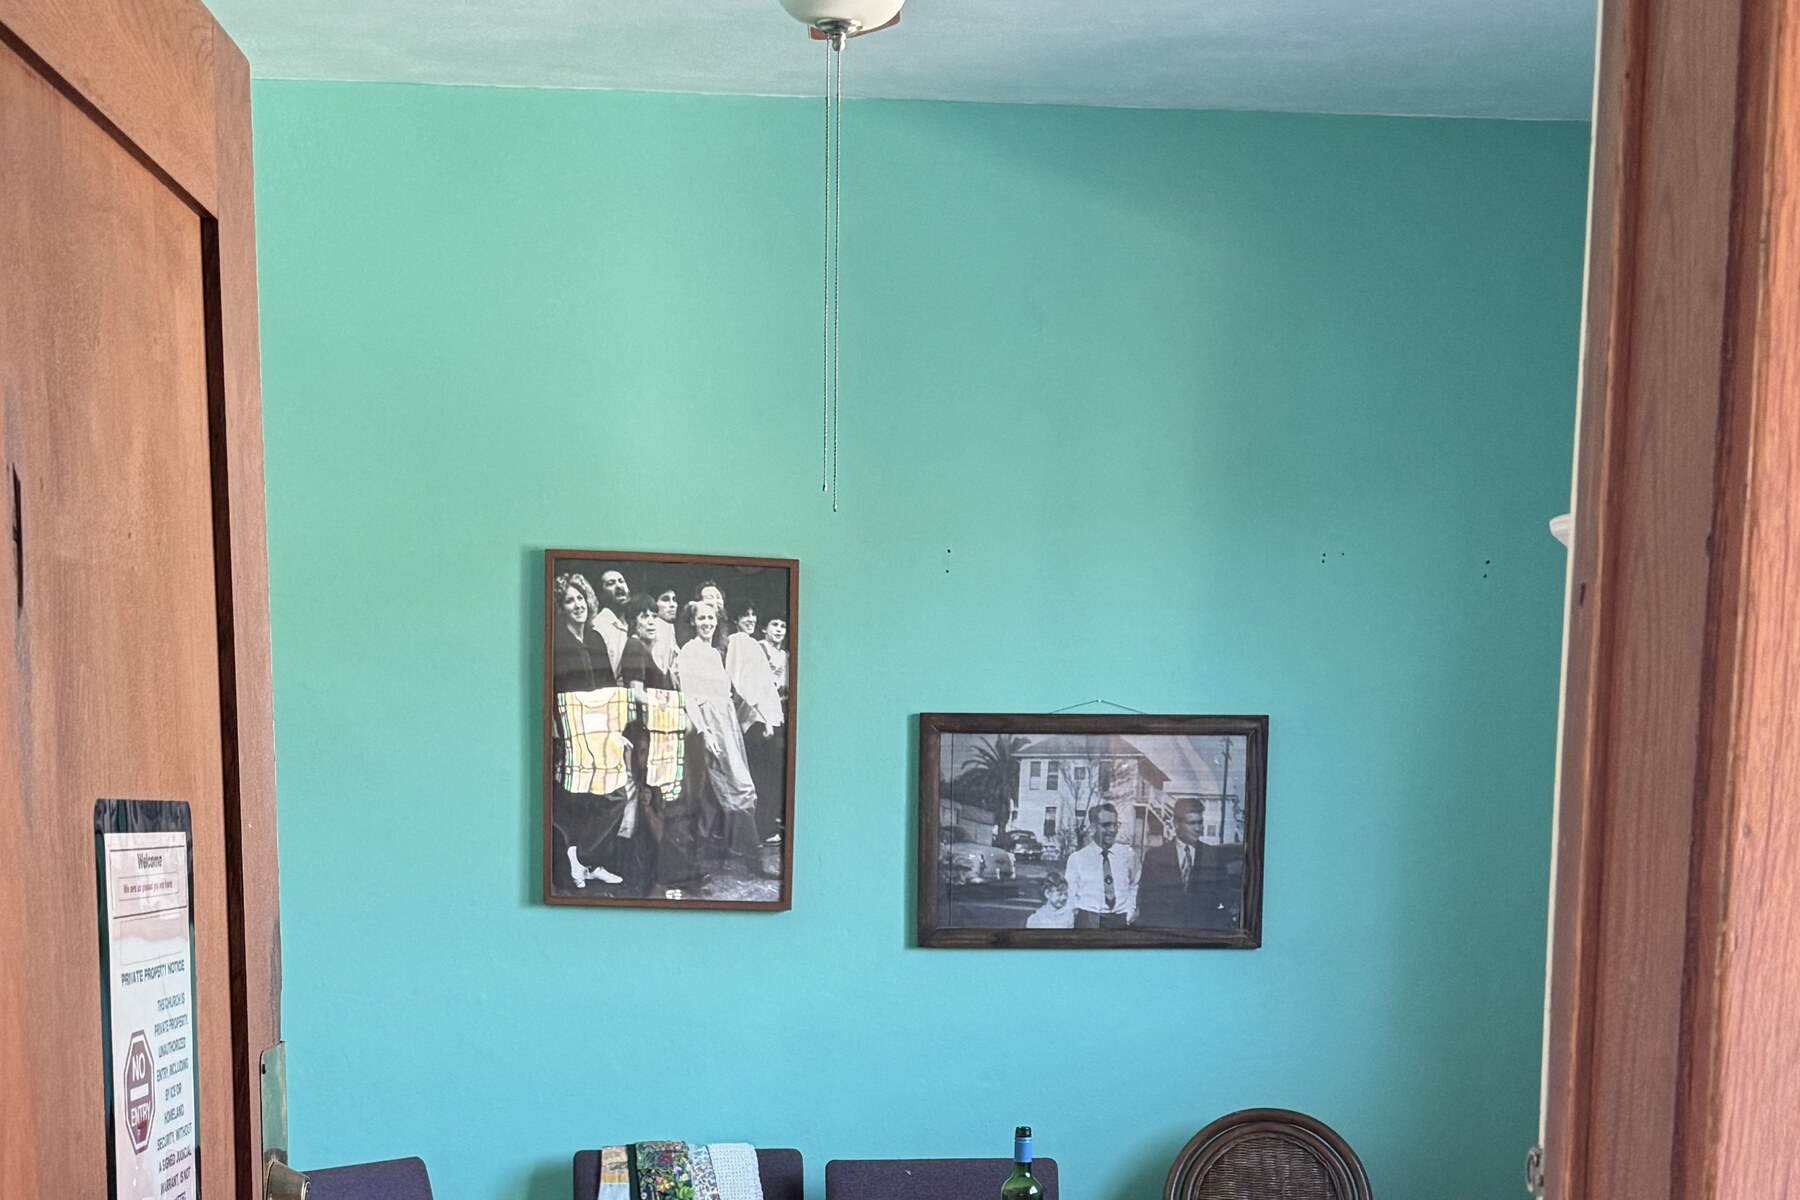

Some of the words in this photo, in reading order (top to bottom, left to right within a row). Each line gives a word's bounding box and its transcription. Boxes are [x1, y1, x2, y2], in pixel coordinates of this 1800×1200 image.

[137, 852, 162, 869] Welcome
[121, 969, 144, 986] PRIVATE
[144, 964, 167, 981] PROPERTY
[167, 959, 185, 974] NOTICE
[165, 994, 180, 1009] CHURCH
[154, 1020, 169, 1036] PRIVATE
[158, 1037, 186, 1058] UNAUTHORIZED
[132, 1052, 146, 1082] NO
[169, 1057, 189, 1076] INCLUDING
[165, 1088, 170, 1101] BY
[176, 1082, 182, 1096] OR
[131, 1100, 151, 1127] ENTRY
[164, 1104, 184, 1124] HOMELAND
[176, 1122, 192, 1140] WITHOUT
[162, 1153, 175, 1171] SIGNED
[176, 1145, 192, 1163] JUDICIAL
[180, 1170, 184, 1184] IS
